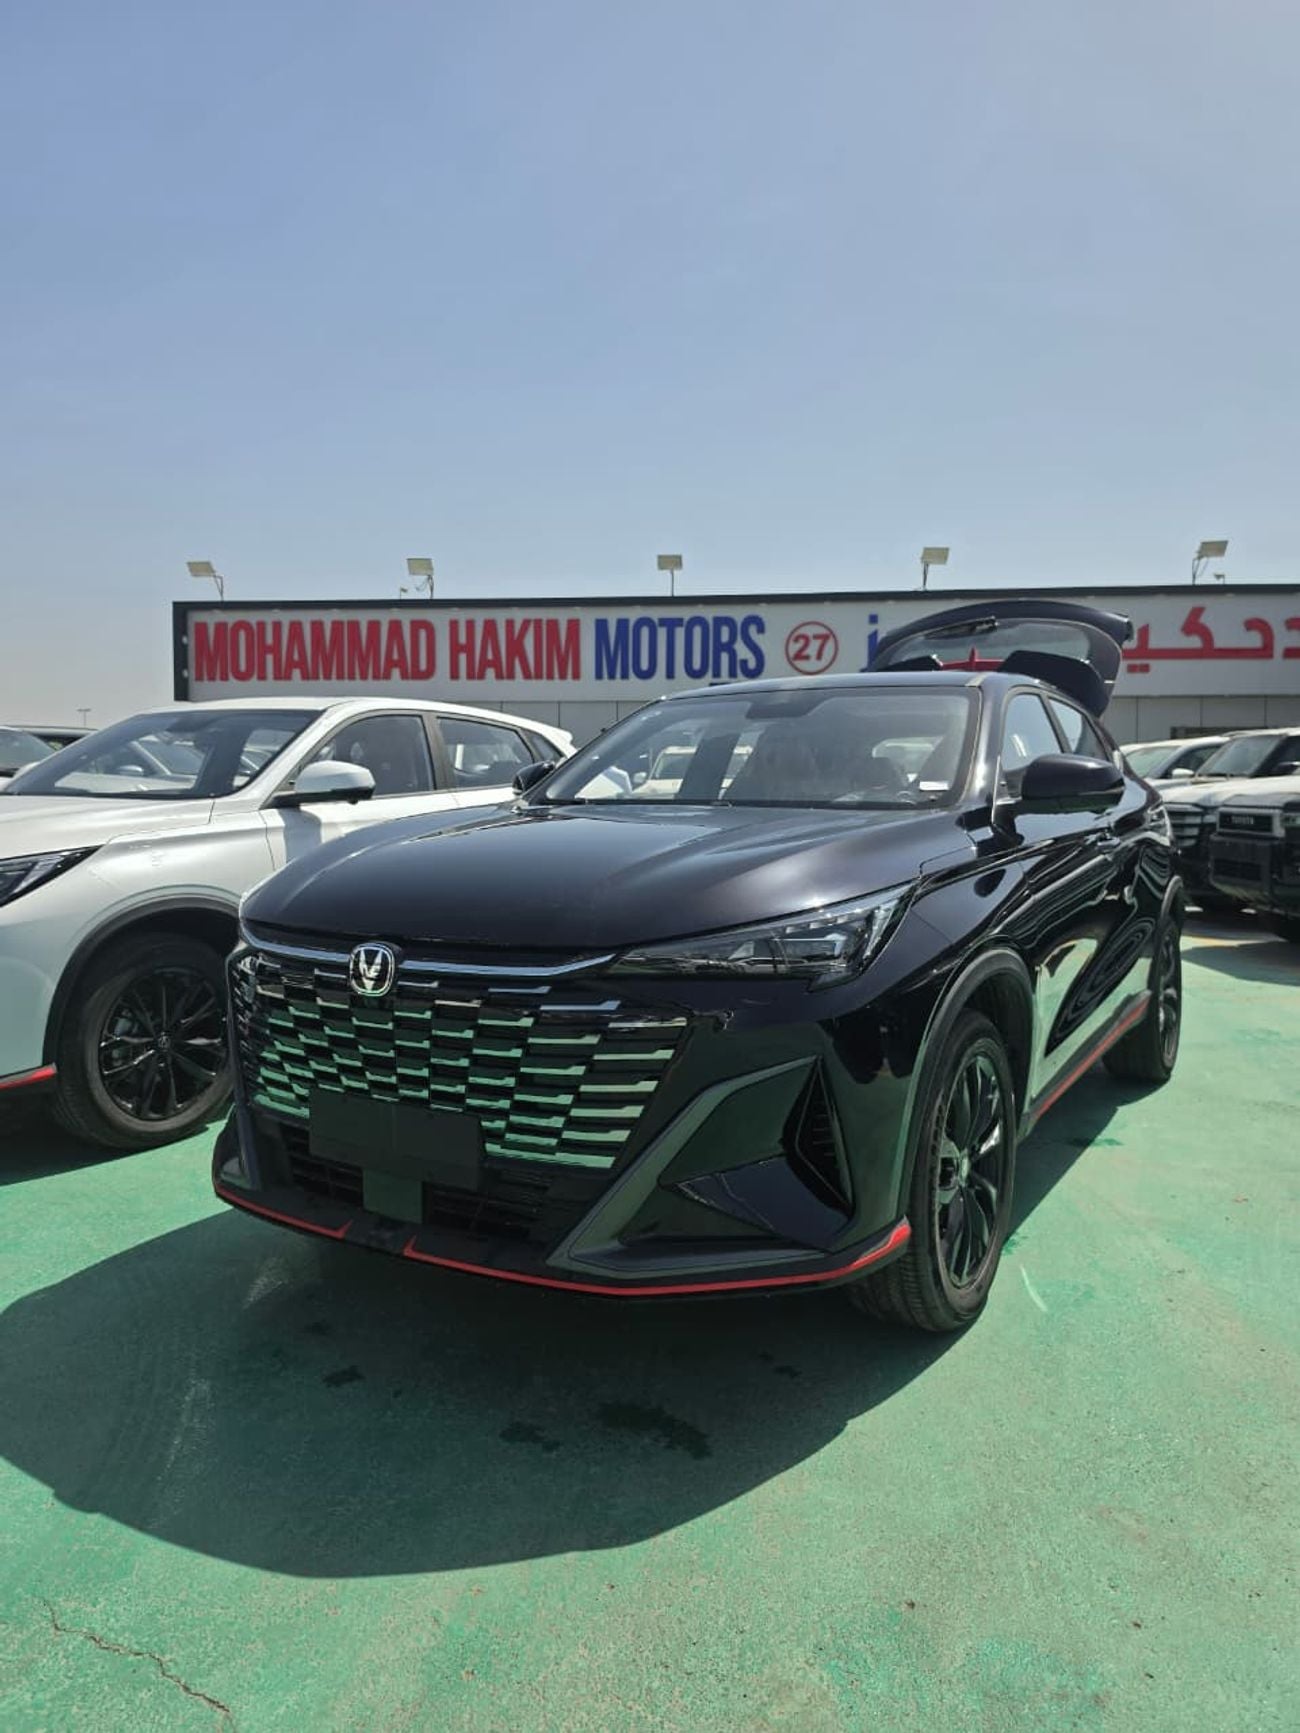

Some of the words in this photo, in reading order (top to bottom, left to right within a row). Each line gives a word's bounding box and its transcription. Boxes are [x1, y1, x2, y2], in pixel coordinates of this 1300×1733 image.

[194, 619, 435, 682] MOHAMMAD
[448, 617, 580, 681] HAKIM
[594, 614, 765, 680] MOTORS
[792, 633, 831, 661] 27
[1122, 607, 1275, 673] حكي
